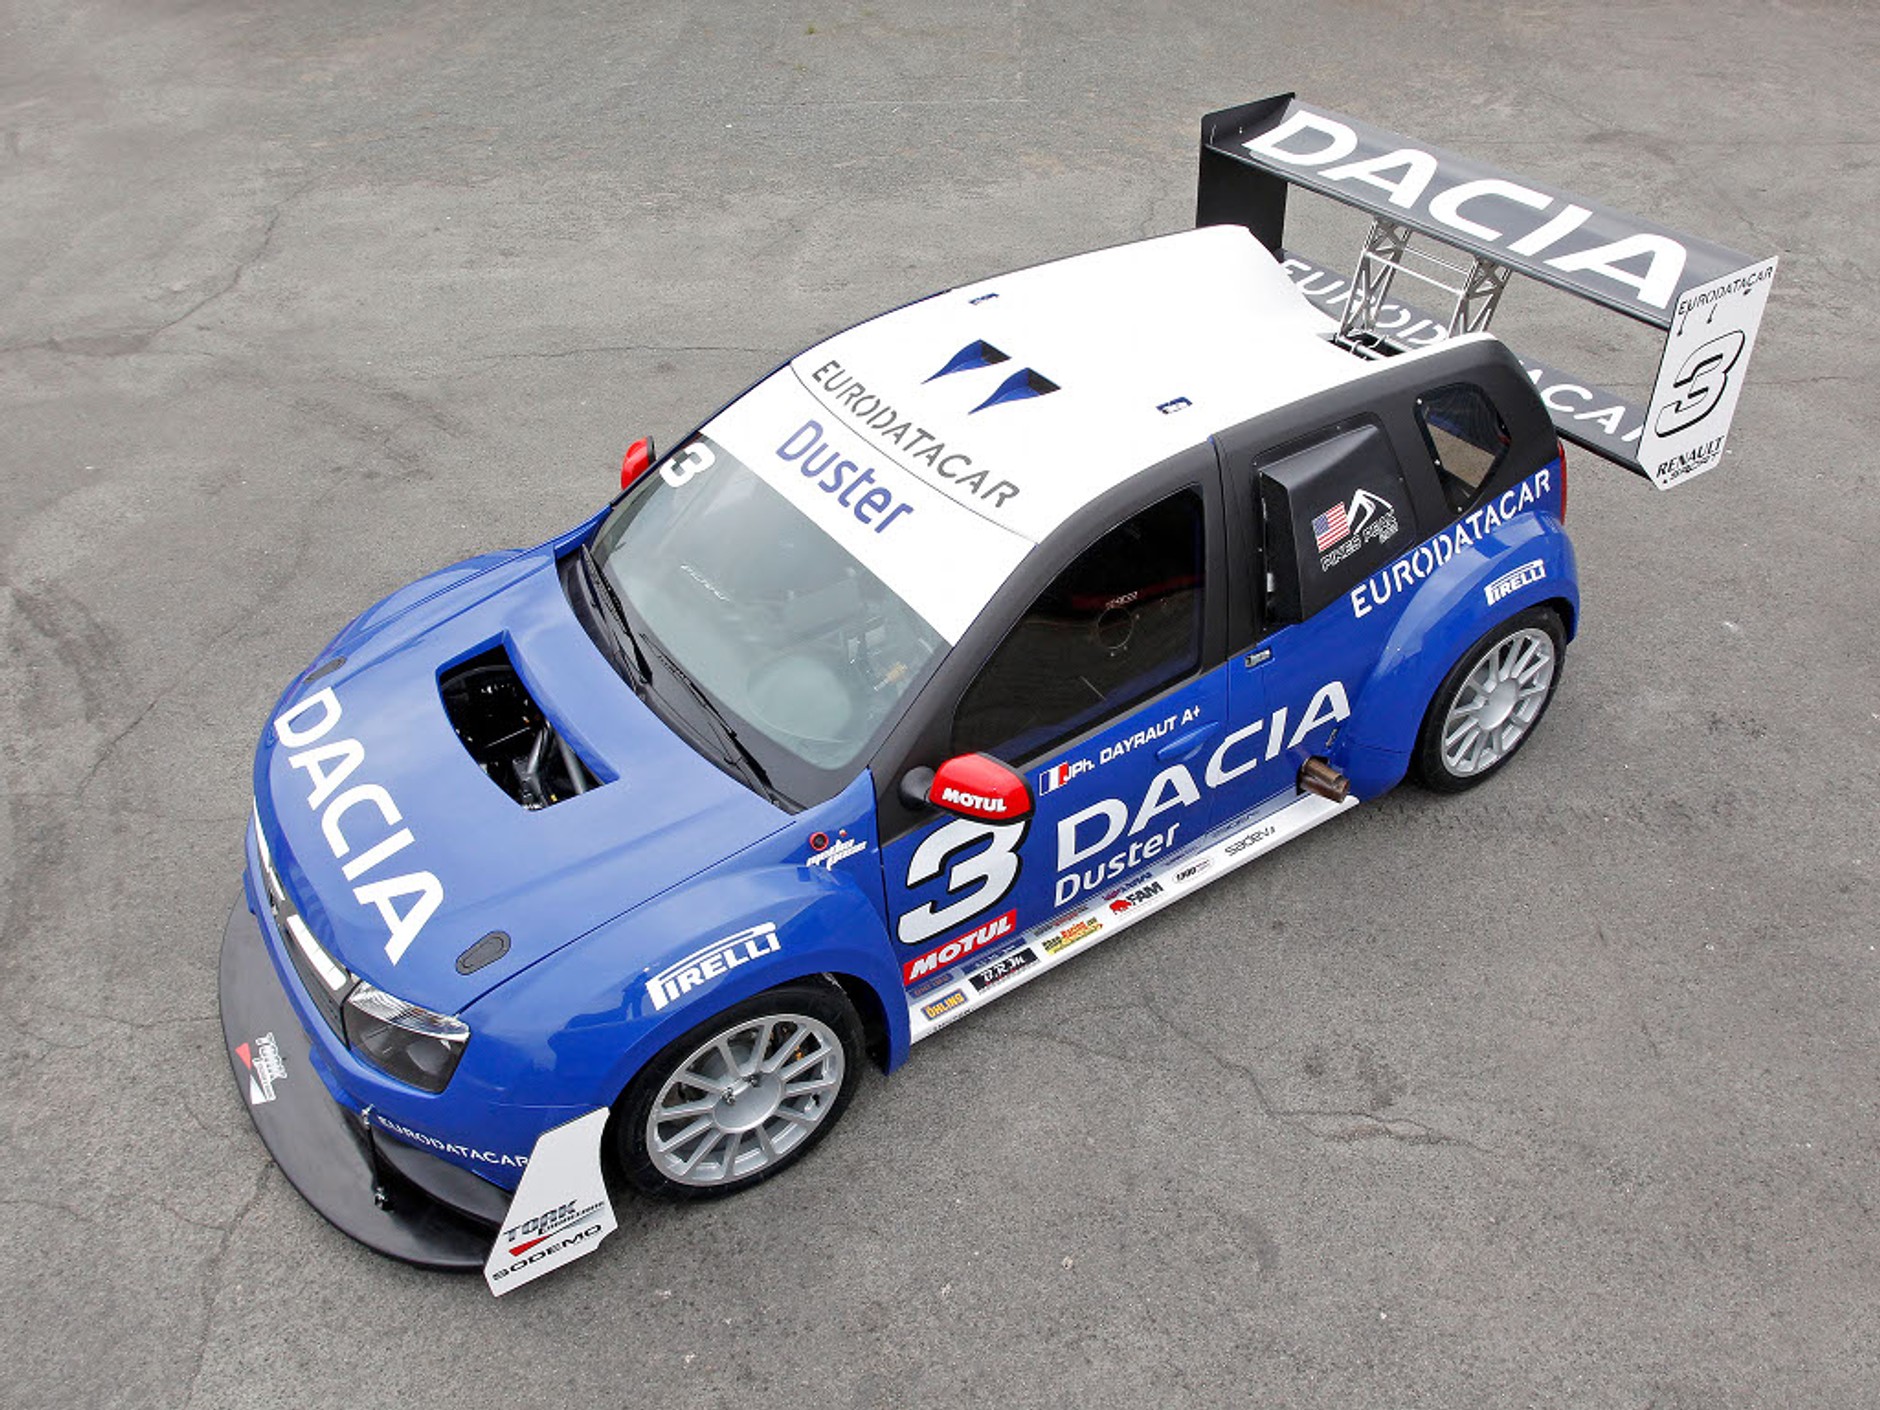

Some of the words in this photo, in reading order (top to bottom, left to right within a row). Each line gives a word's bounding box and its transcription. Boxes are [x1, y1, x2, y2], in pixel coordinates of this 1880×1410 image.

[1242, 109, 1688, 309] DACIA
[1678, 266, 1774, 316] EURODATACAR
[1654, 329, 1746, 438] 3
[659, 442, 716, 488] 3
[774, 418, 914, 535] Duster
[811, 359, 1020, 508] EURODATACAR
[1655, 435, 1725, 479] RENAULT
[1350, 468, 1551, 618] EURODATACAR
[1484, 559, 1546, 606] PIRELLI
[1057, 680, 1351, 873] DACIA
[1100, 715, 1177, 765] DAYRAUT
[273, 686, 444, 966] DACIA
[941, 786, 1008, 814] MOTUL
[898, 817, 1030, 946] 3
[1054, 821, 1180, 907] Duster
[1126, 881, 1164, 906] FAM
[644, 921, 782, 1012] PIRELLI
[909, 915, 1013, 980] MOTUL
[377, 1114, 529, 1168] EURODATACAR
